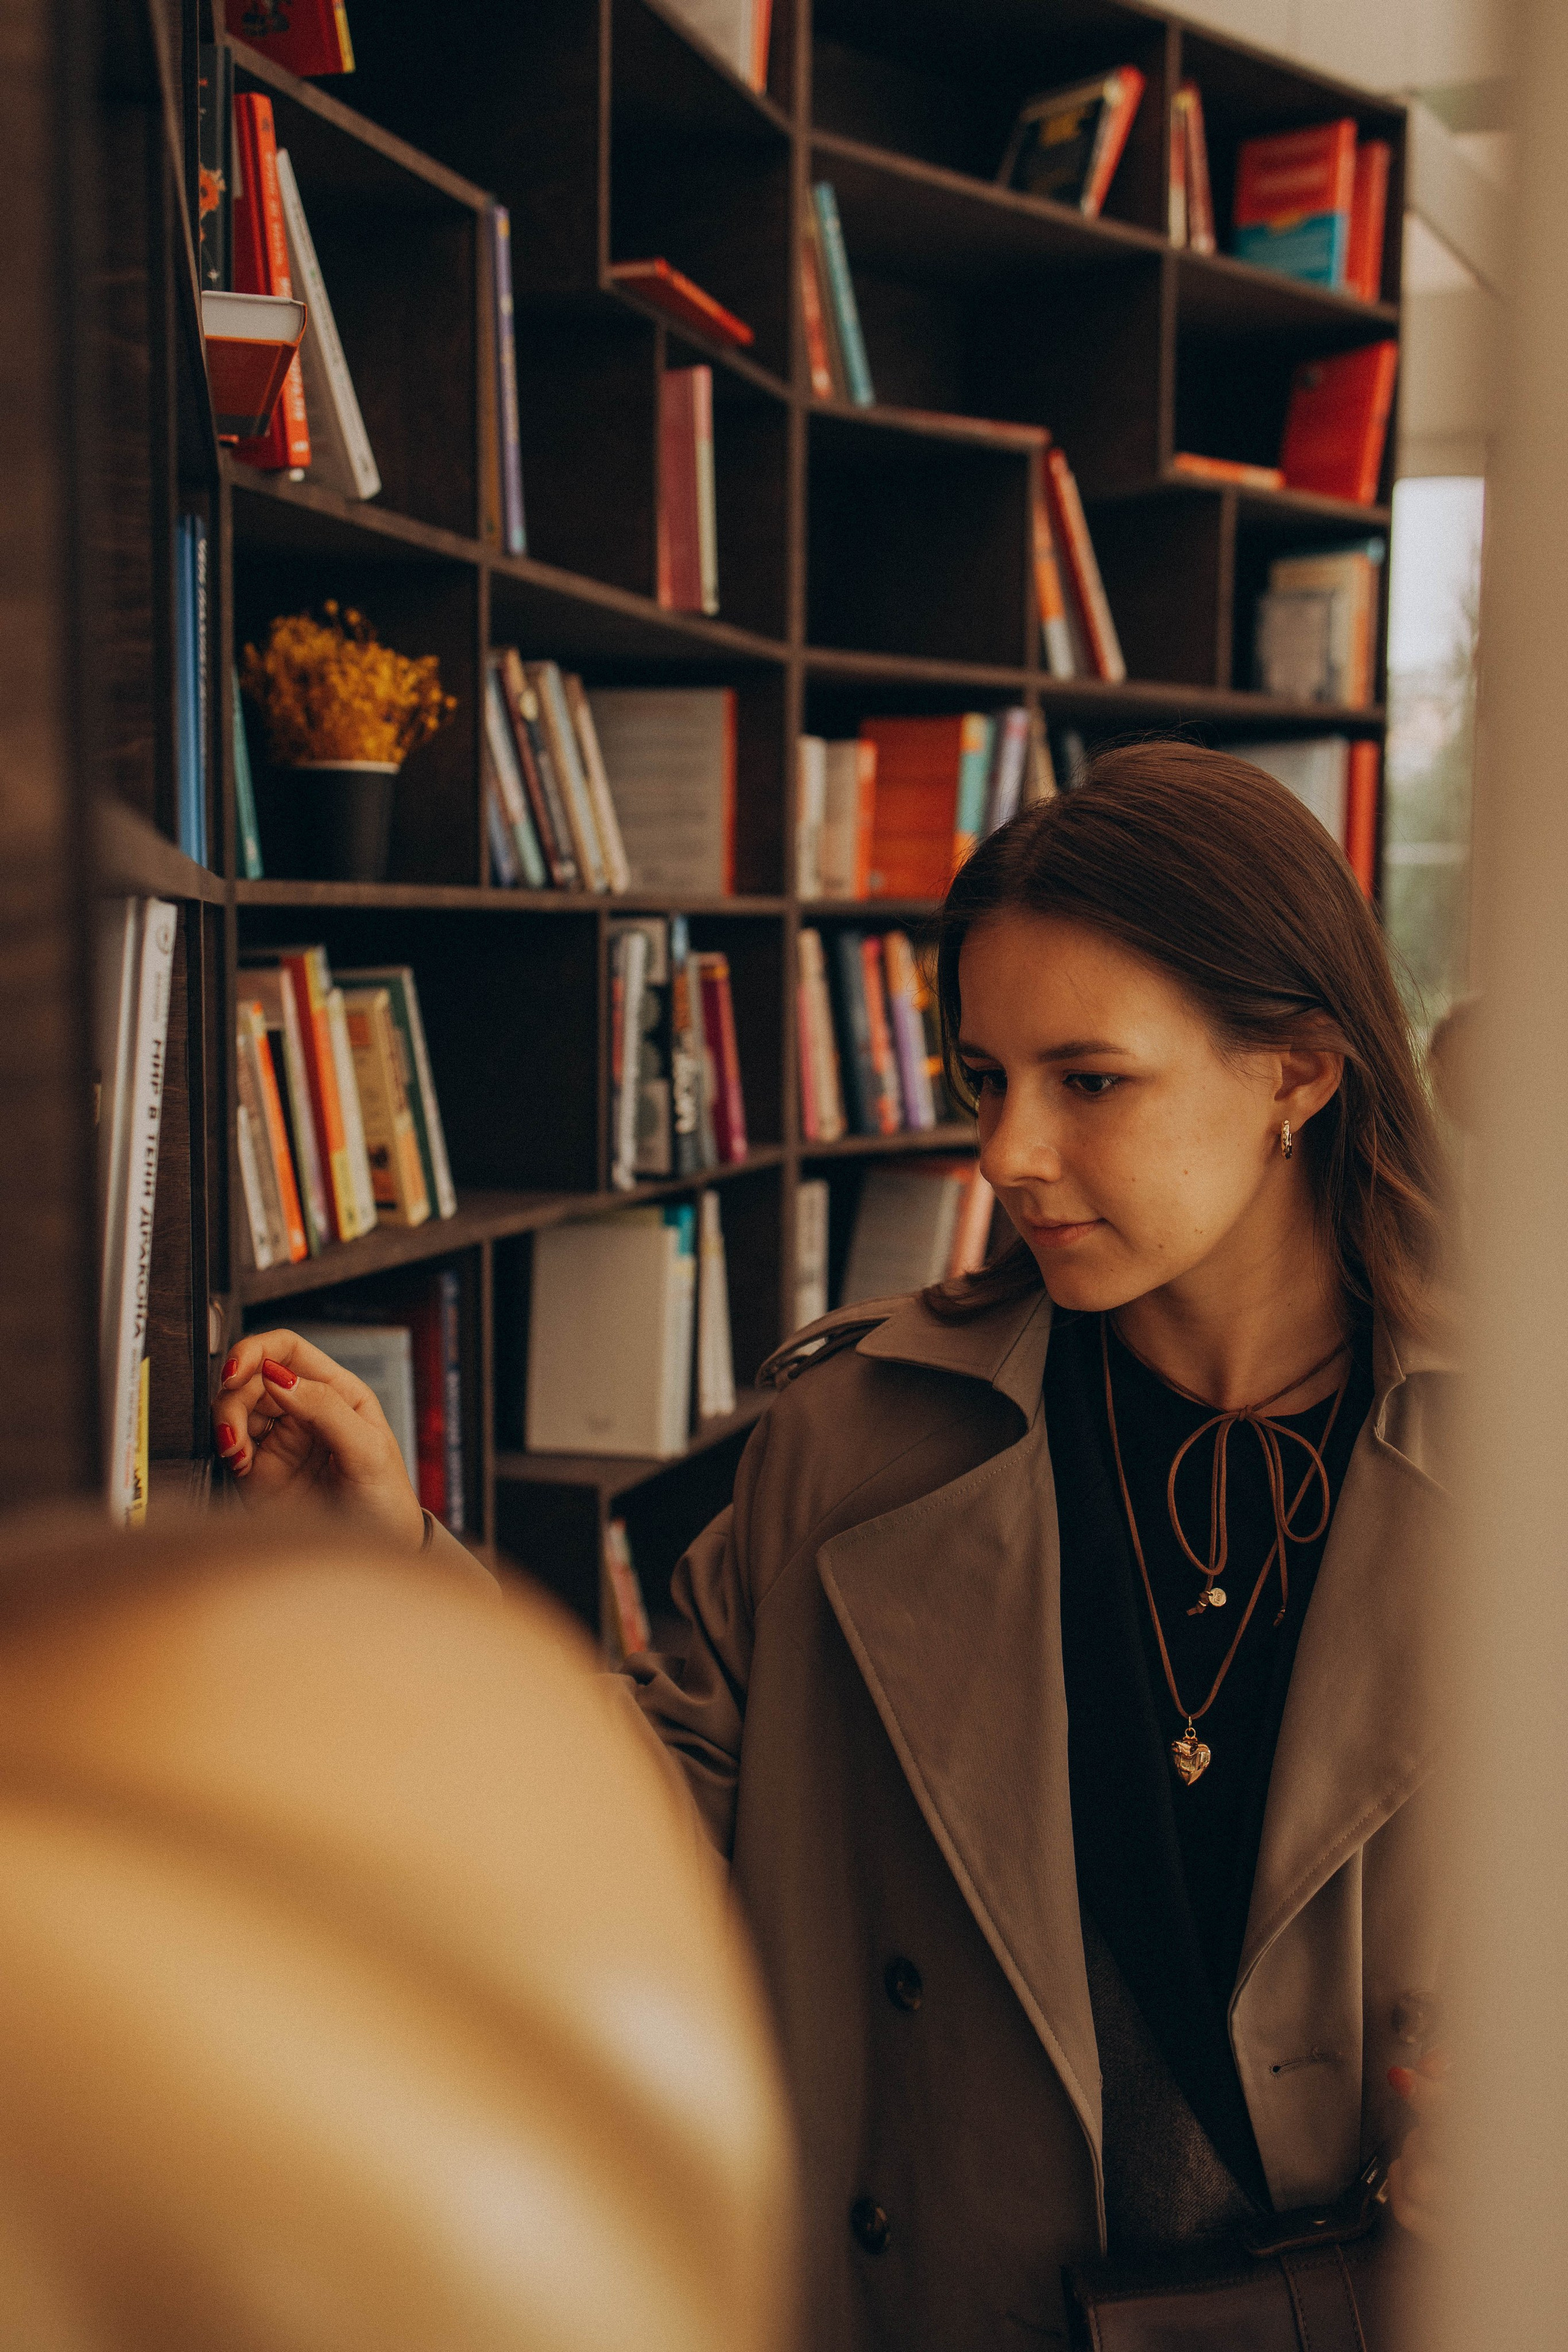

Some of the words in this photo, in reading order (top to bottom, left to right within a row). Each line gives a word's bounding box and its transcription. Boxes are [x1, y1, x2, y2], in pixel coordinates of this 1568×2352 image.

[151, 1039, 163, 1095] МИР
[148, 1106, 159, 1120] В
[144, 1133, 157, 1196] ТЕНИ
[135, 1207, 153, 1338] ДРАКОНА
